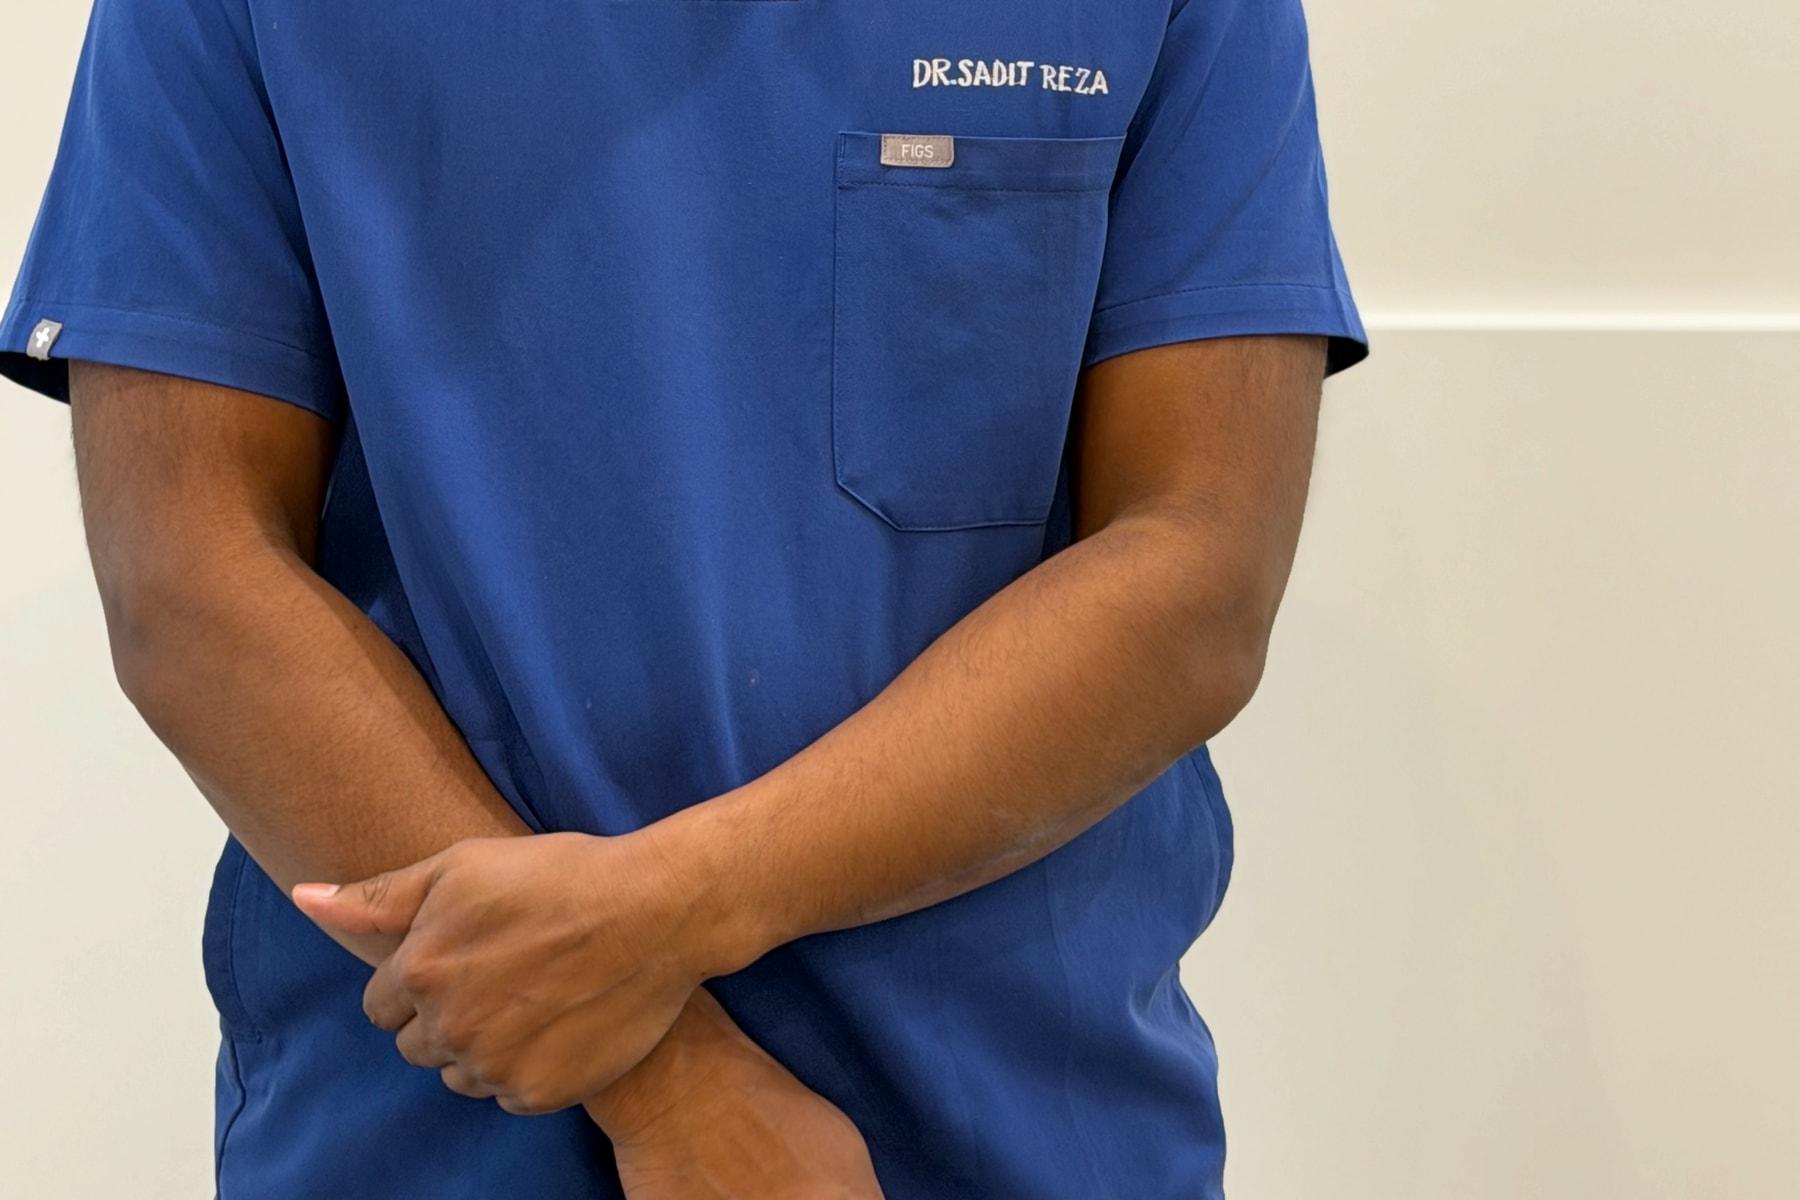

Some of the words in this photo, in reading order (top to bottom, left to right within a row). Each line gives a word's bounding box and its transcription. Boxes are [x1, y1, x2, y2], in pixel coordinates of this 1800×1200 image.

[912, 58, 1034, 88] DR.SADIT
[1039, 65, 1108, 94] REZA
[901, 143, 934, 159] FIGS
